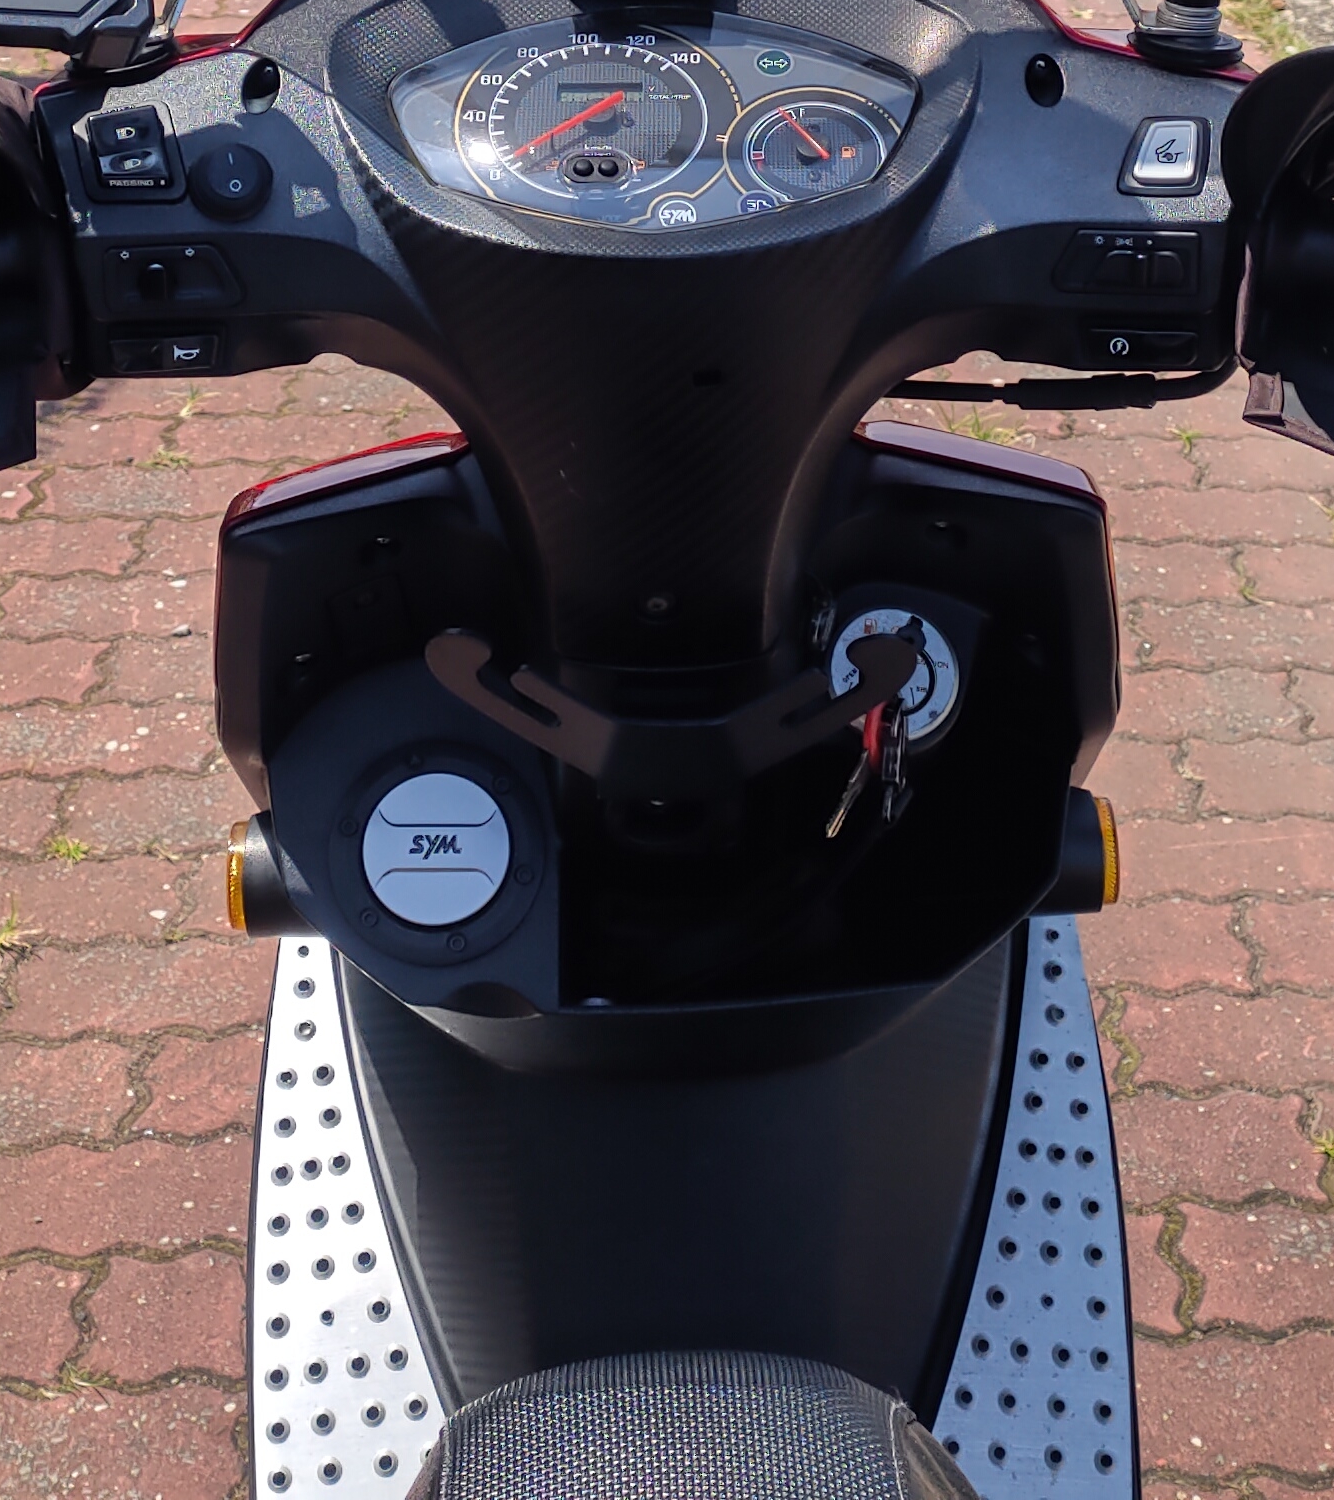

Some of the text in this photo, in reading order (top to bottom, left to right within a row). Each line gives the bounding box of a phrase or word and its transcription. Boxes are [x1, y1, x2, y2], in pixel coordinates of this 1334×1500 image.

[568, 33, 599, 45] 100
[626, 35, 656, 46] 120
[517, 47, 539, 58] 80
[670, 52, 701, 64] 140
[480, 74, 503, 86] 60
[462, 110, 487, 122] 40
[108, 179, 155, 187] PASSING
[661, 209, 695, 224] SYM
[408, 834, 463, 860] SYM
